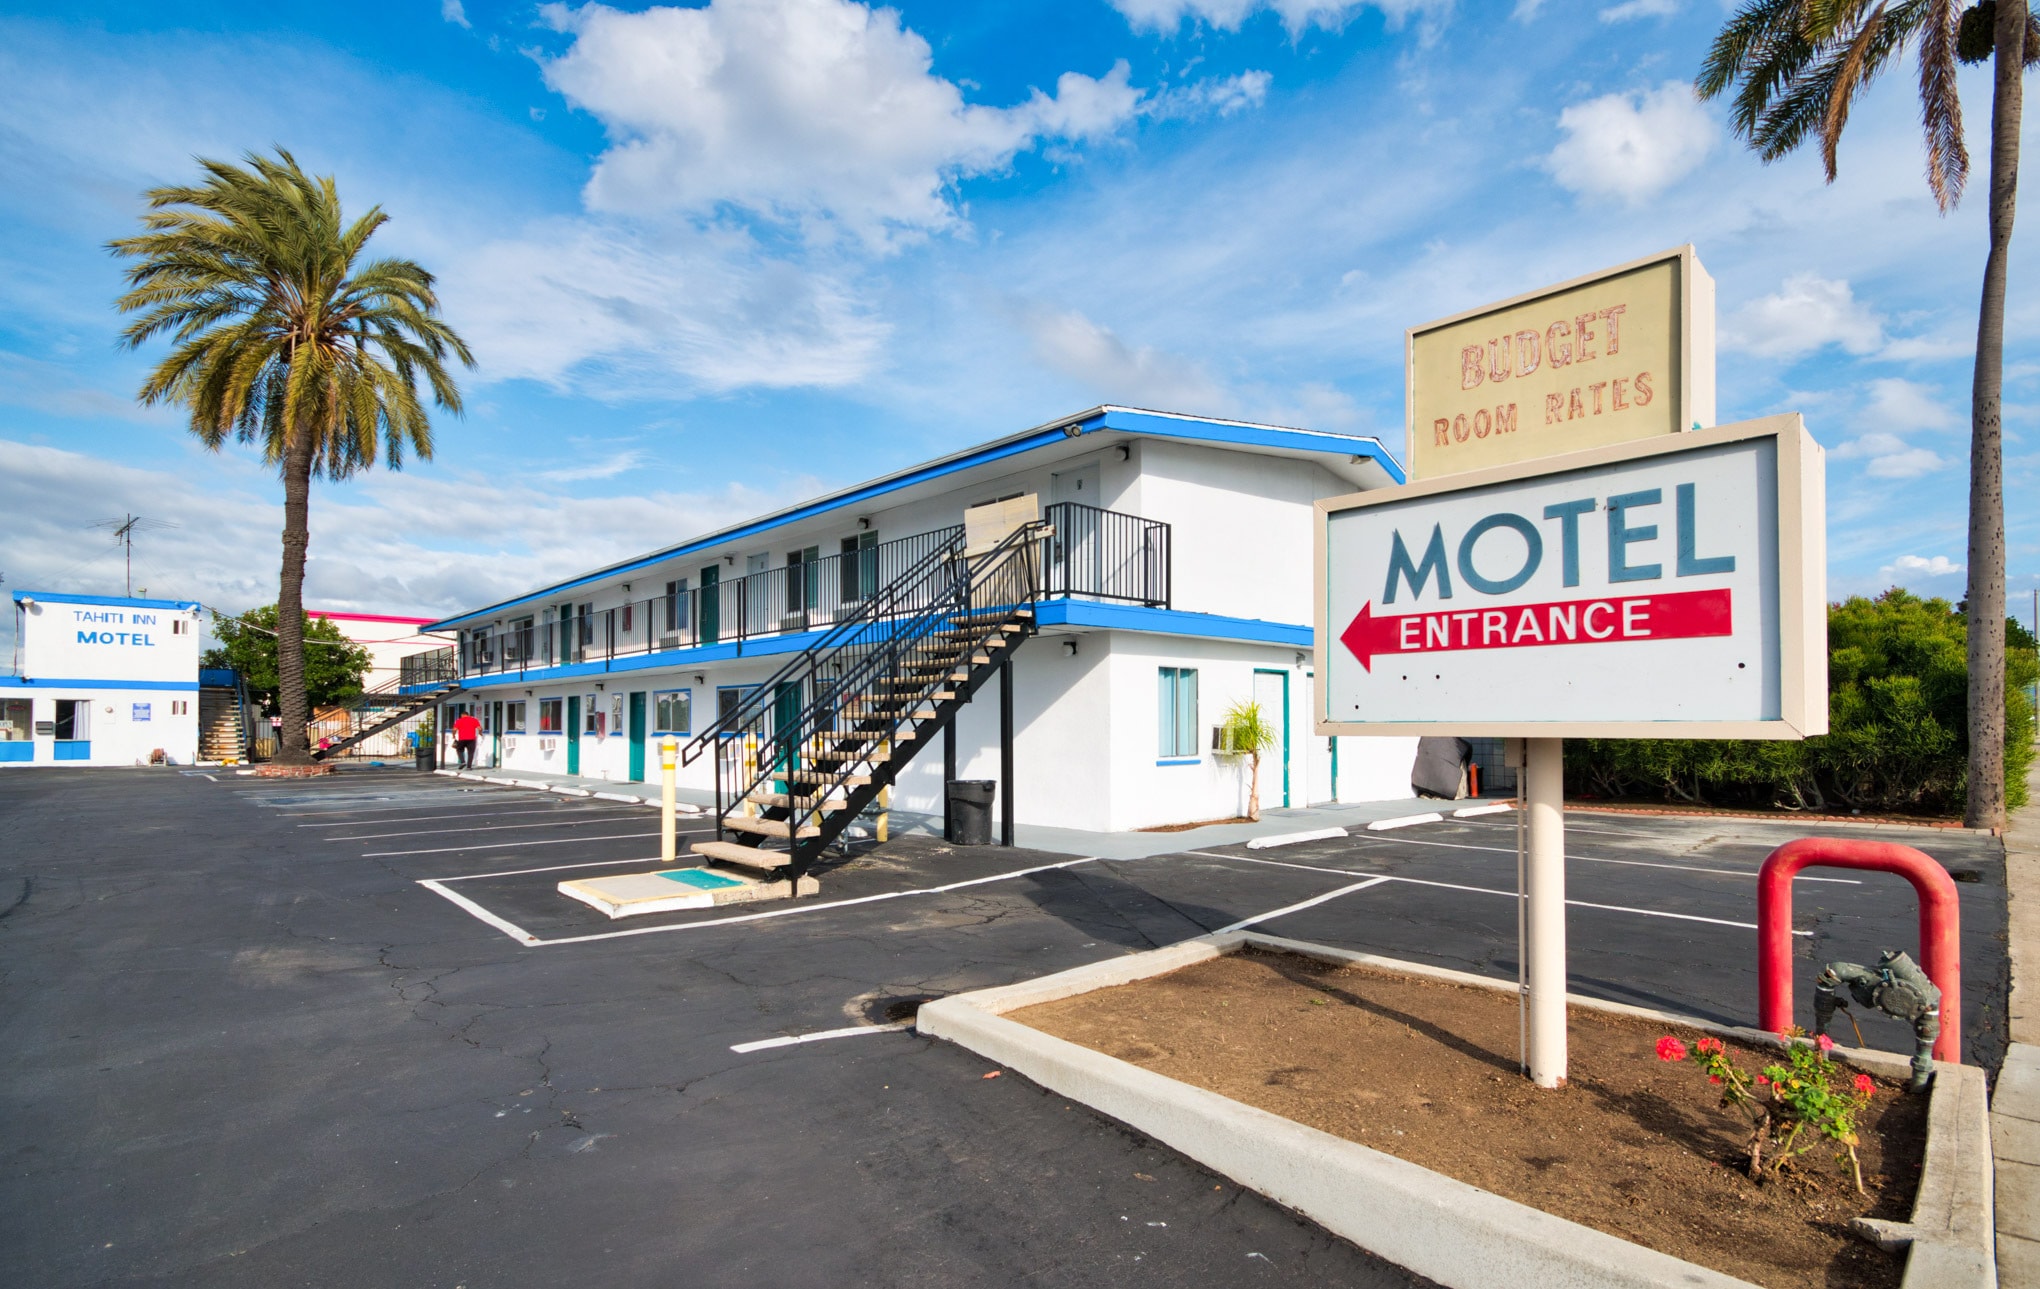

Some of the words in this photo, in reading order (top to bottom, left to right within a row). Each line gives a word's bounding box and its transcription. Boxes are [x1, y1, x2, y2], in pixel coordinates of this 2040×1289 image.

[1462, 304, 1626, 390] BUDGET
[1434, 403, 1517, 446] ROOM
[1545, 371, 1654, 424] RATES
[1382, 483, 1735, 604] MOTEL
[73, 611, 123, 624] TAHITI
[133, 614, 156, 625] INN
[77, 631, 155, 646] MOTEL
[1400, 599, 1652, 650] ENTRANCE
